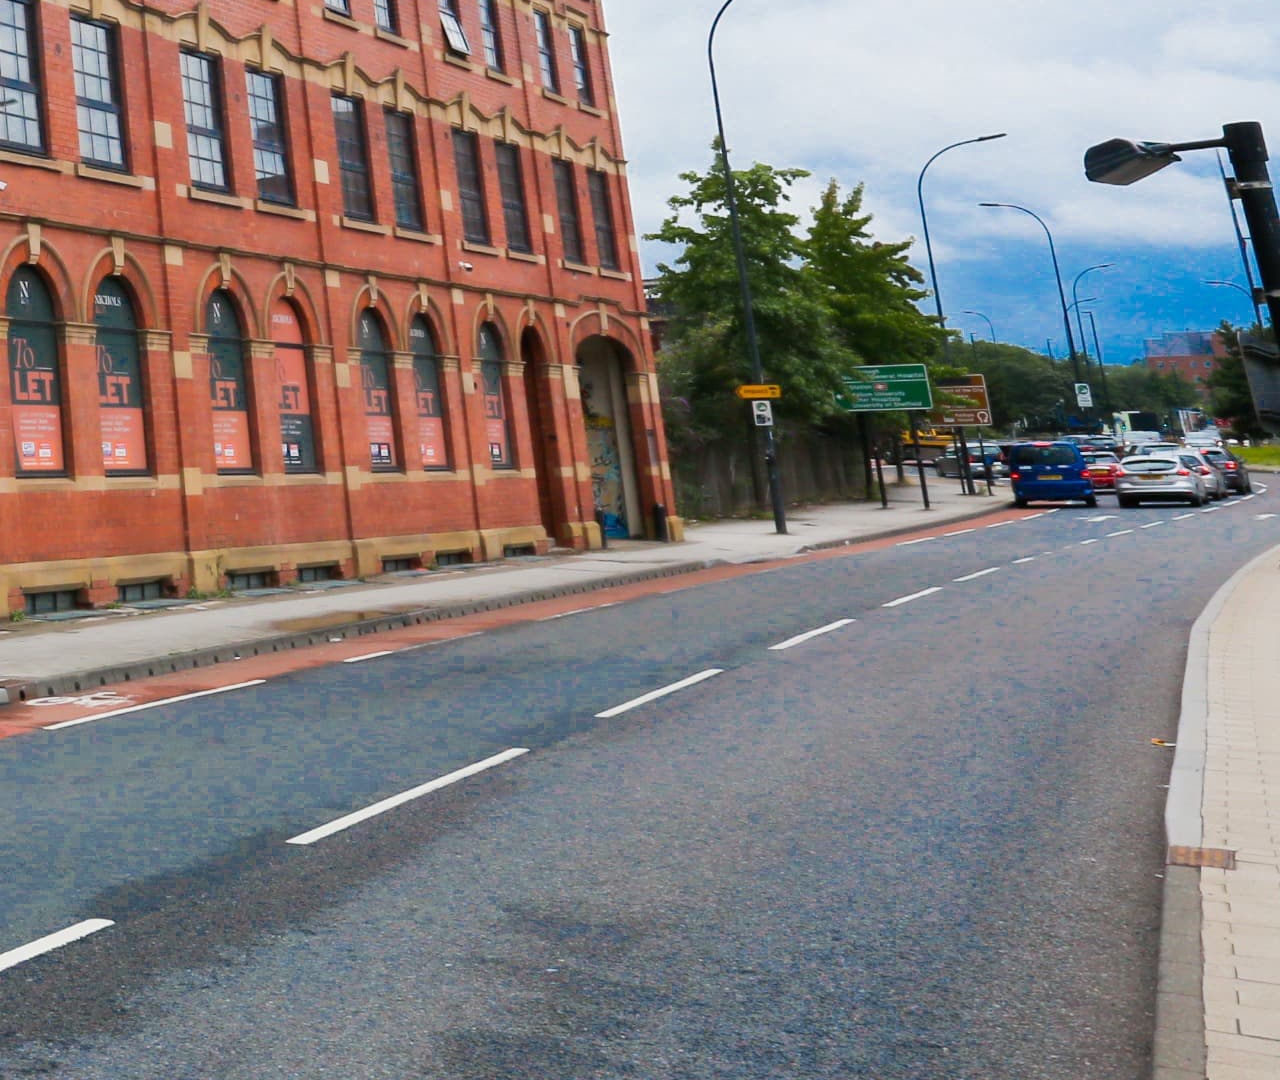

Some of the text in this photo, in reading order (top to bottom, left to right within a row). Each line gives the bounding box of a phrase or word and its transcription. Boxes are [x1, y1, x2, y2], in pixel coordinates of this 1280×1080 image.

[20, 280, 29, 298] N
[13, 337, 34, 369] To
[14, 370, 54, 401] LET
